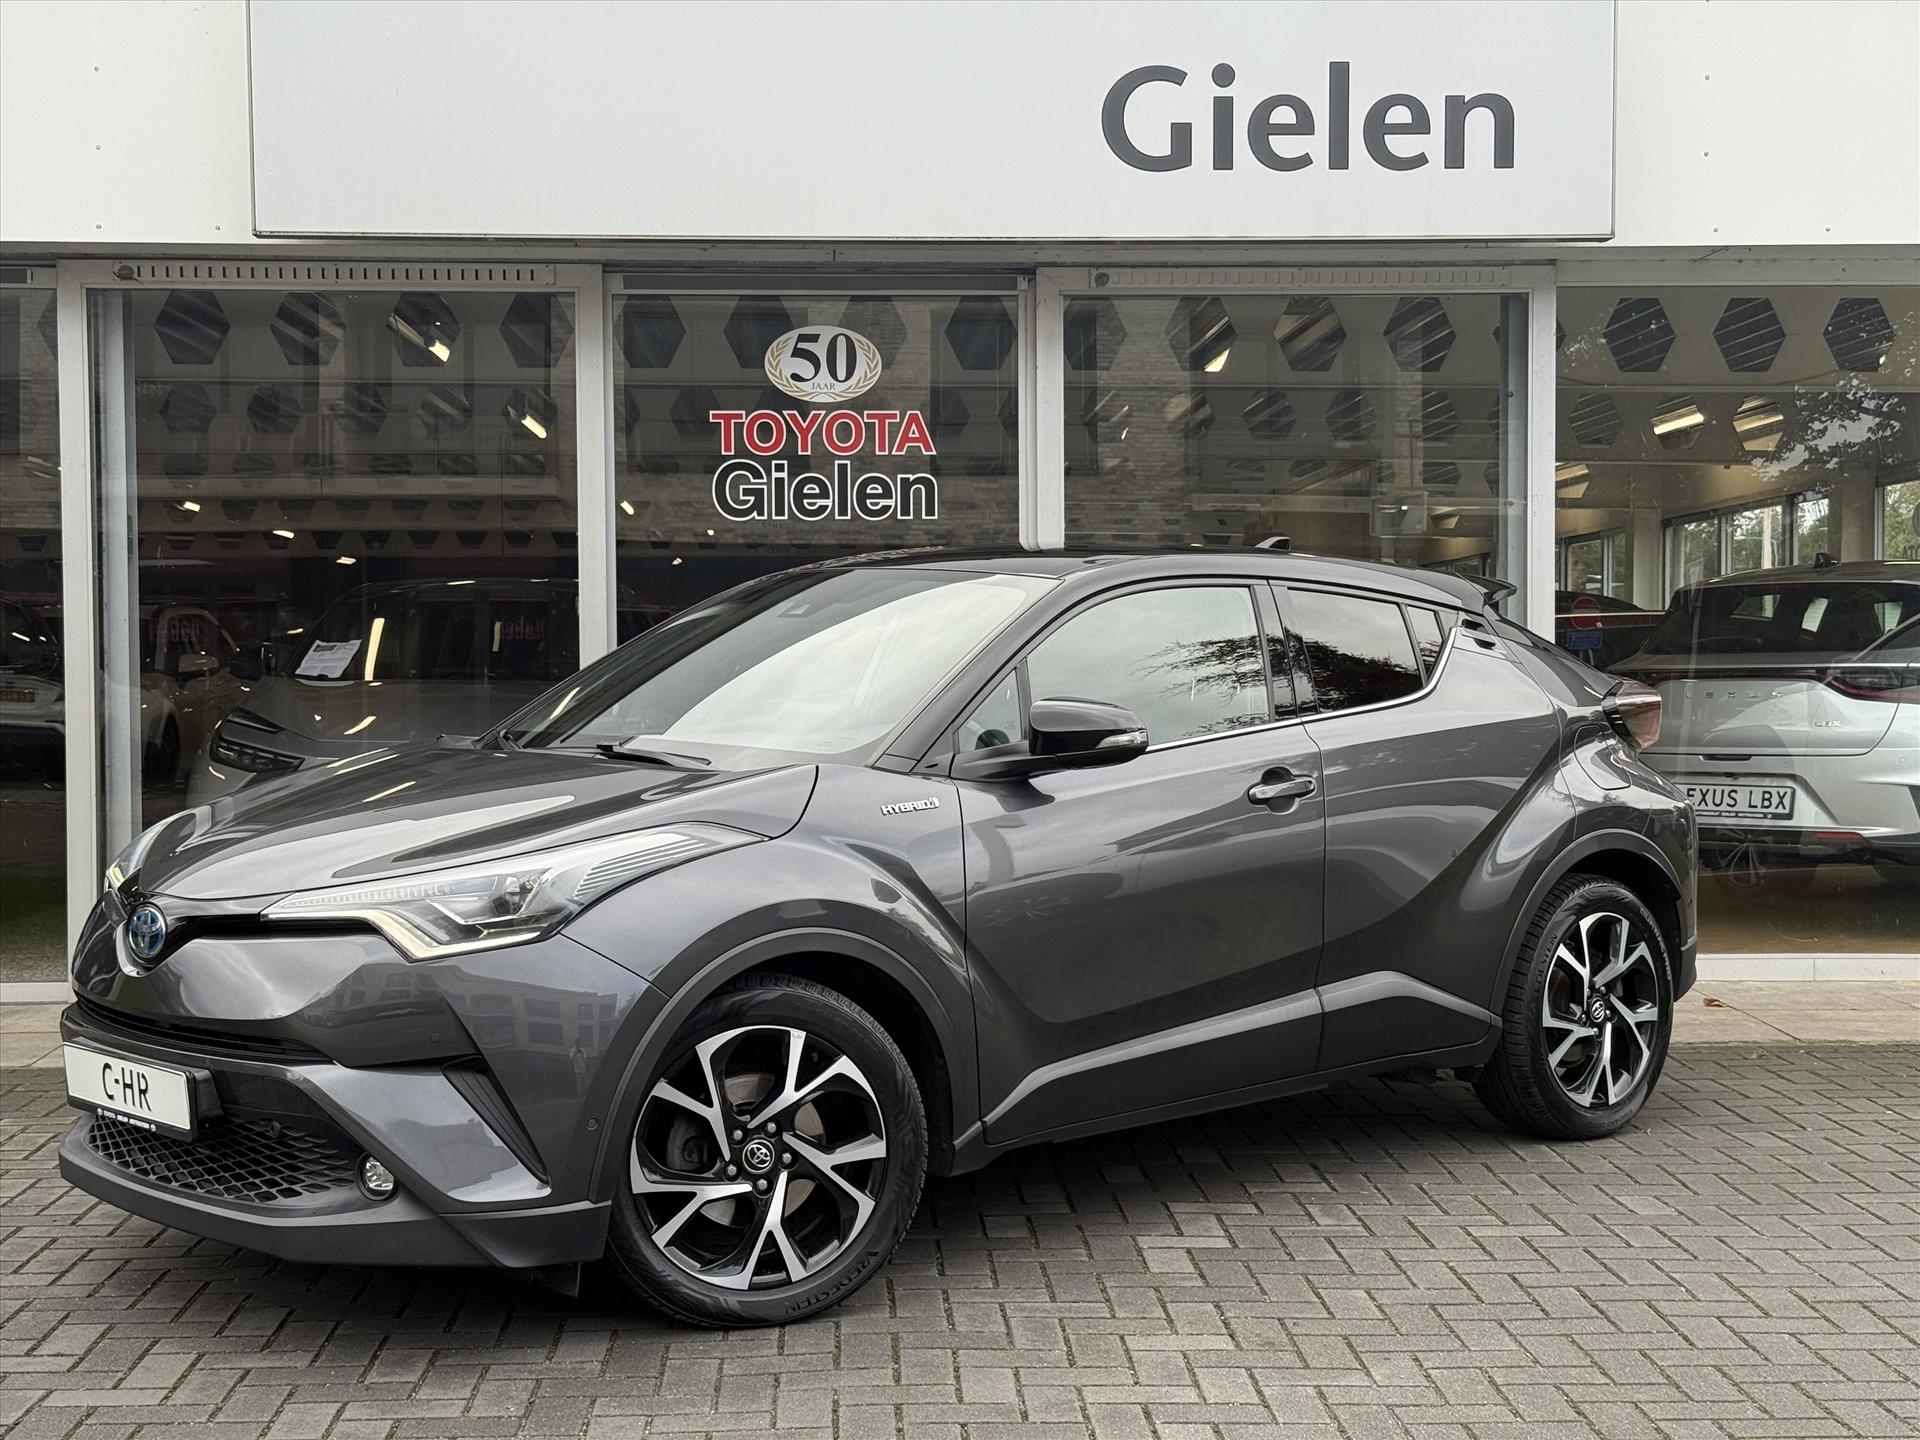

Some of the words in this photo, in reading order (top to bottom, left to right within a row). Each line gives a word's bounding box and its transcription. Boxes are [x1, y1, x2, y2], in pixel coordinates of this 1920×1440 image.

[1101, 61, 1515, 172] Gielen
[789, 333, 858, 383] 50
[811, 382, 836, 391] JAAR
[709, 410, 937, 456] TOYOTA
[712, 459, 938, 521] Gielen
[880, 800, 930, 816] HYBRID
[1686, 787, 1739, 808] EXUS
[1747, 790, 1788, 810] LBX
[102, 1062, 152, 1112] C-HR
